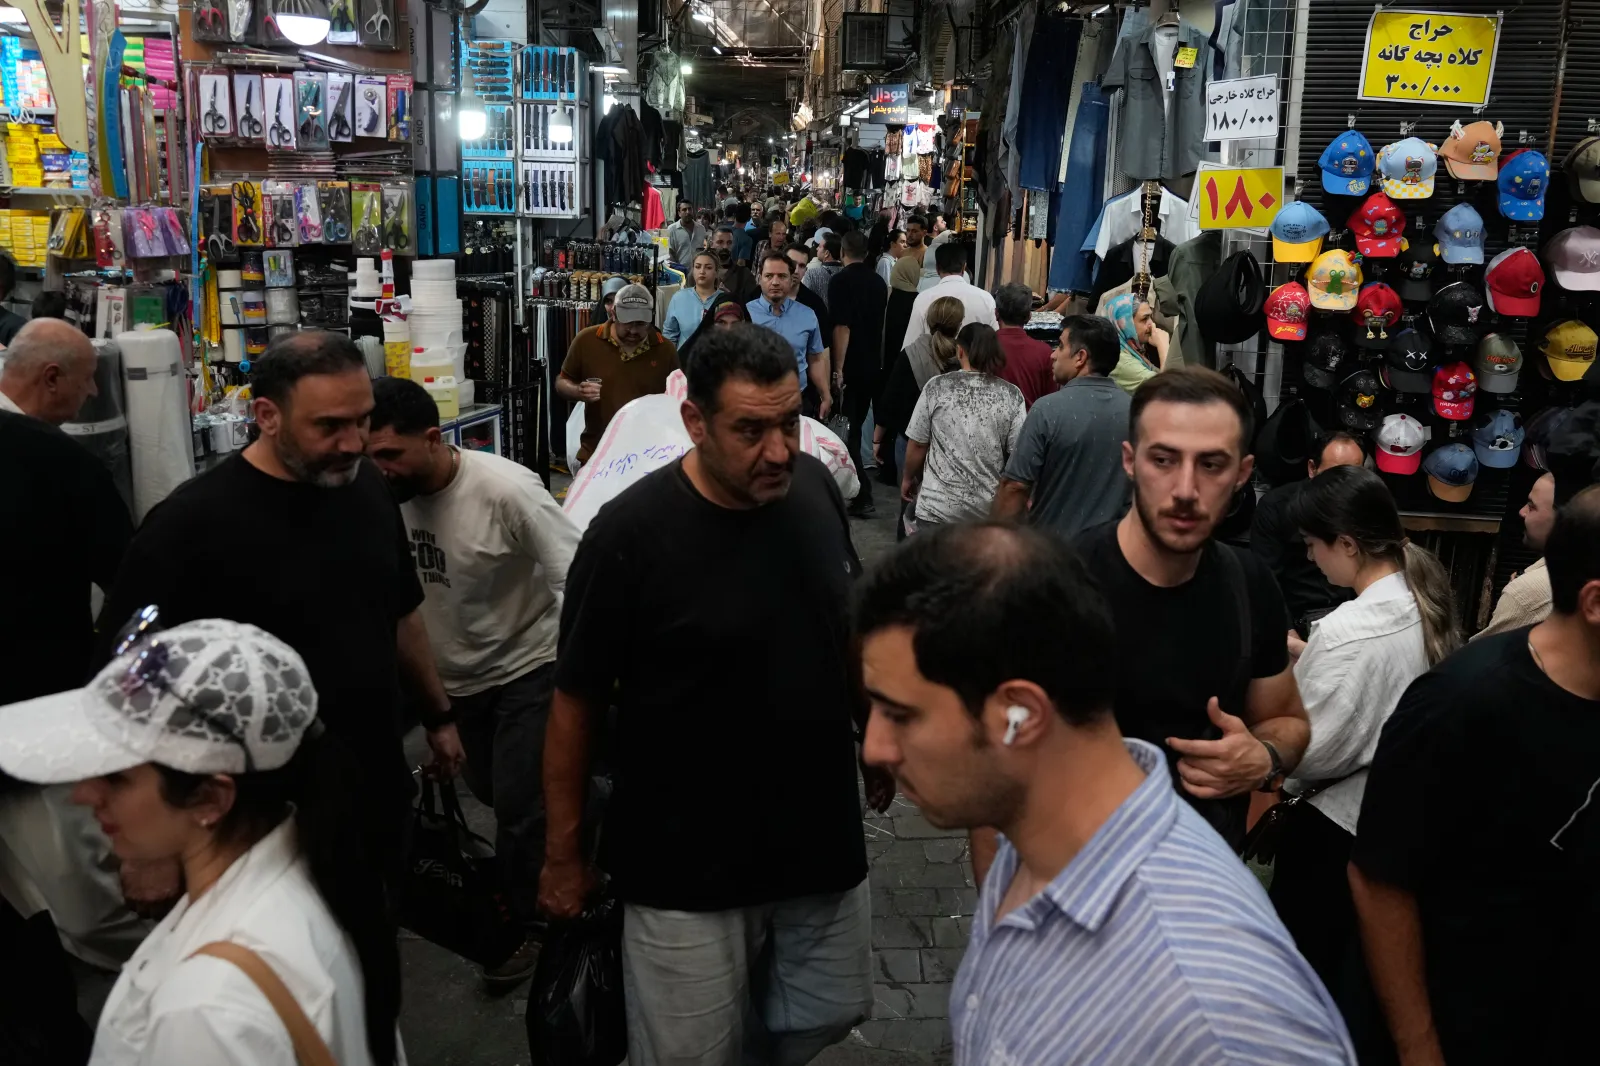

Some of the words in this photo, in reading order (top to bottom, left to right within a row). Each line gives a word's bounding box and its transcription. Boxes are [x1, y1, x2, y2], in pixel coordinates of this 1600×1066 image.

[1408, 18, 1453, 42] حراج
[1377, 44, 1411, 62] گانه
[1413, 49, 1443, 70] بچه
[1447, 47, 1483, 66] کلاه
[1239, 88, 1255, 99] کلاه
[1256, 87, 1276, 100] حراج
[1385, 73, 1461, 97] ۳۰۰/۰۰۰
[1209, 91, 1238, 105] خارجی
[870, 105, 886, 114] پخش
[892, 105, 906, 114] تولید
[1212, 108, 1274, 132] ۱۸۰/۰۰۰
[416, 119, 424, 146] GANO
[1205, 175, 1276, 221] ۱۸۰
[411, 528, 435, 545] WITH
